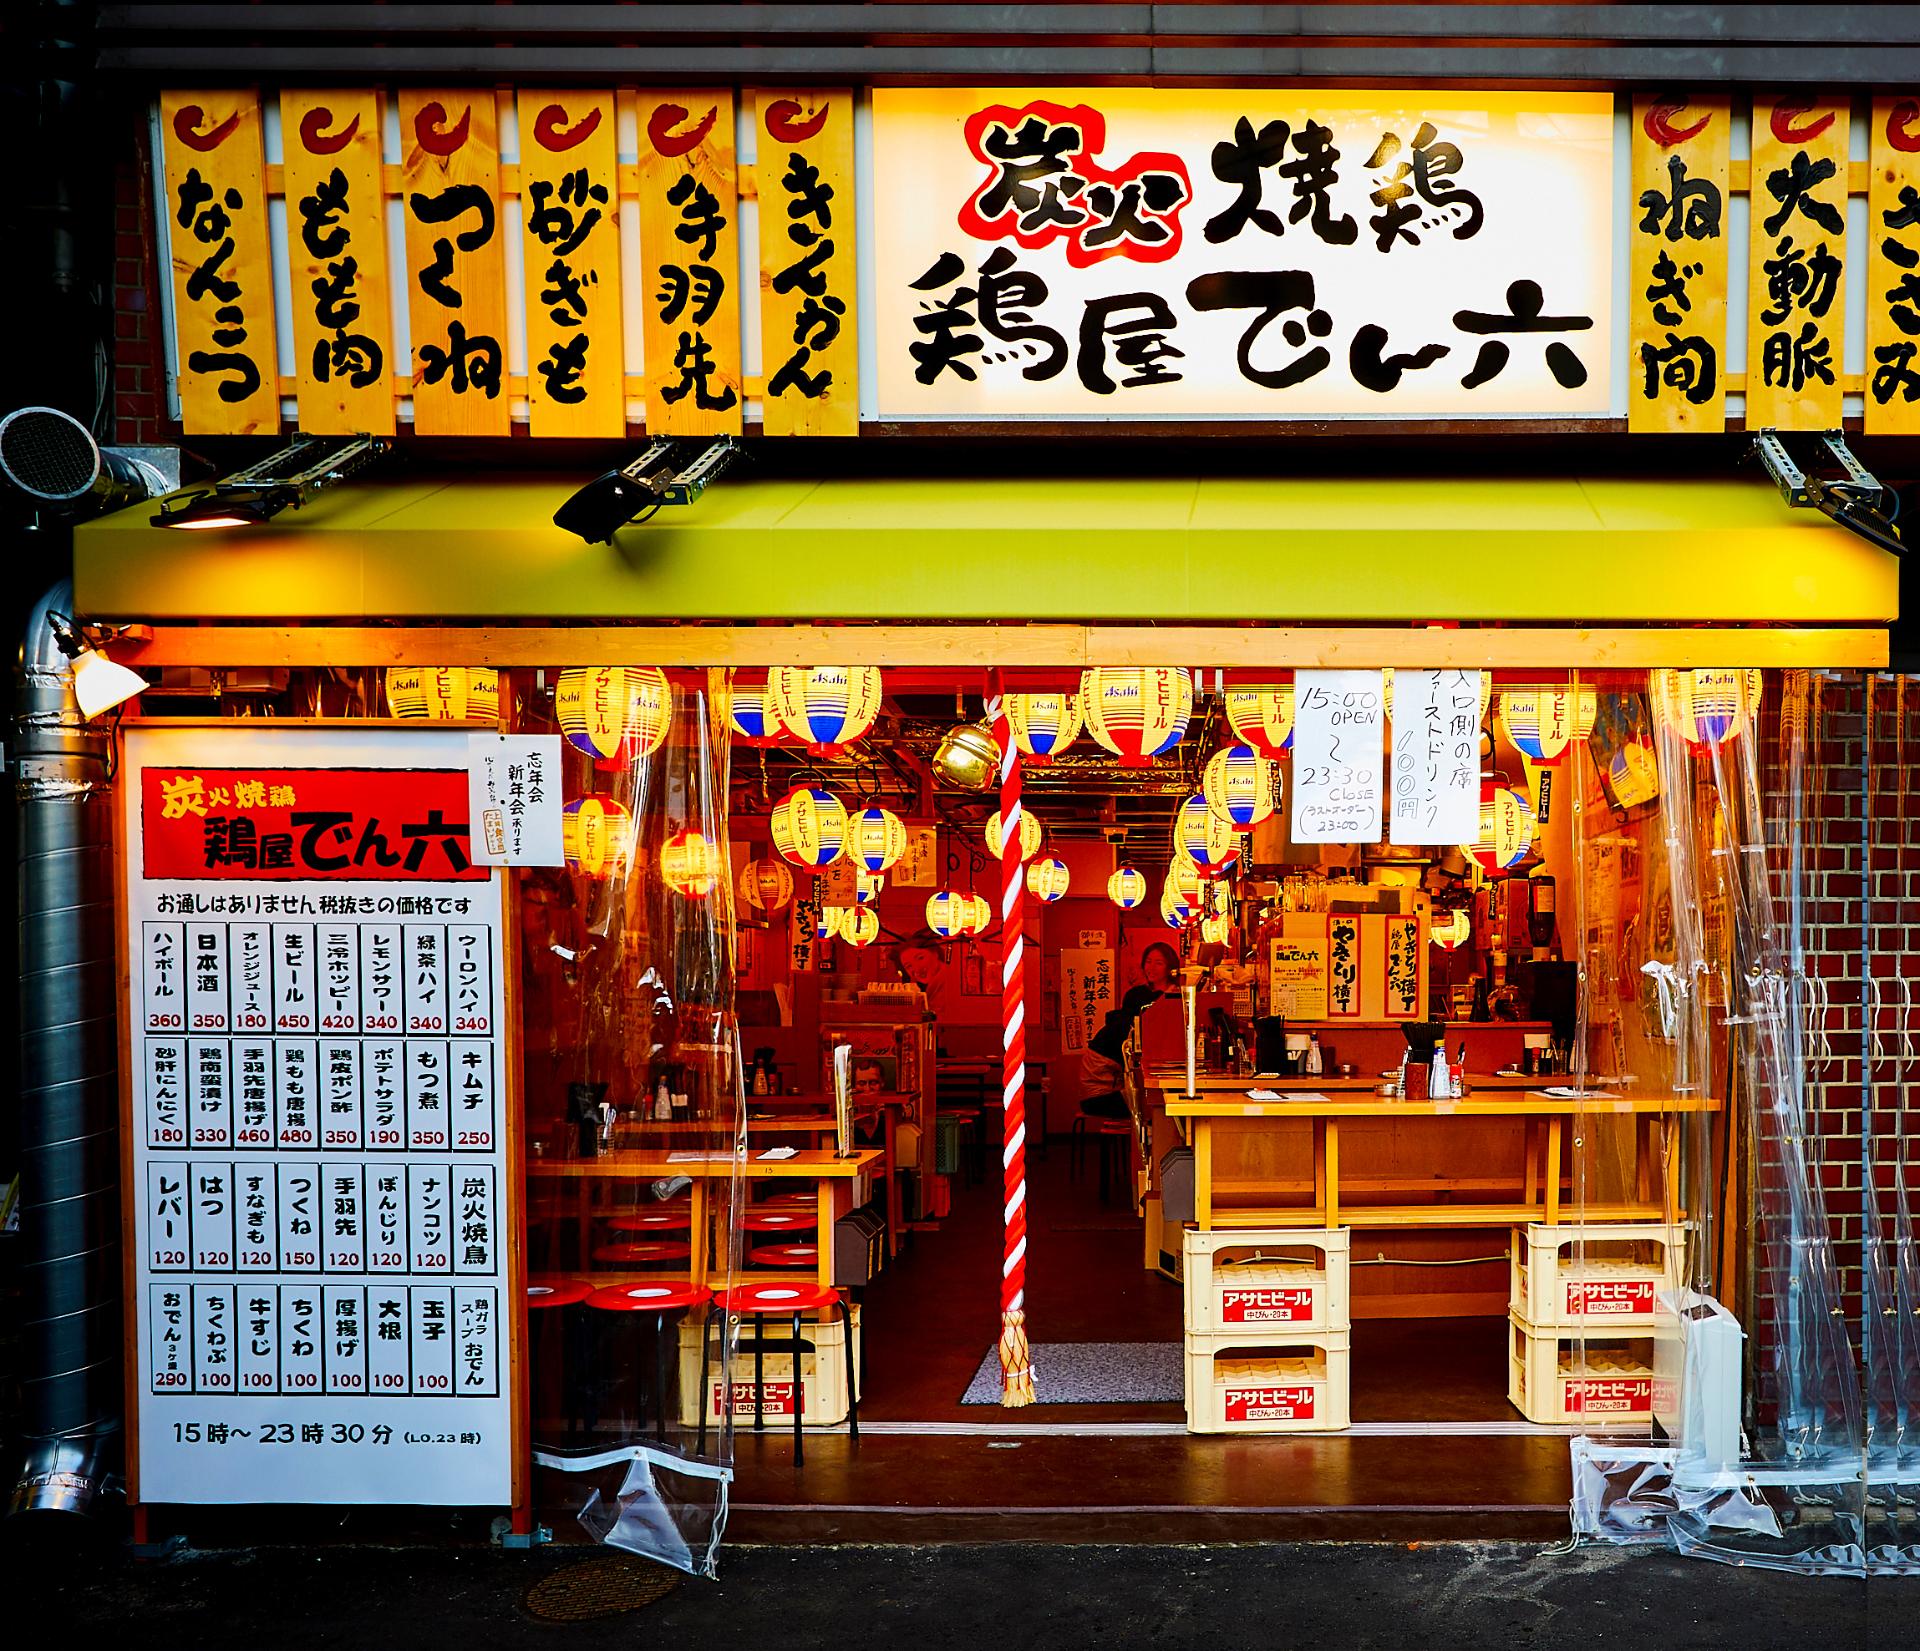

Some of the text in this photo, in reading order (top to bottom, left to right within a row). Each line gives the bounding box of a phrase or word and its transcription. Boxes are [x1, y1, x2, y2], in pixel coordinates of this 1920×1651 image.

[177, 168, 260, 403] なんこつ
[299, 167, 383, 389] もも肉
[528, 168, 609, 404] 砂ぎも
[767, 152, 846, 400] きんかん
[1639, 153, 1722, 402] ねぎ間
[1760, 149, 1844, 391] 大動脈
[411, 184, 501, 400] つくね
[655, 174, 738, 412] 手羽先
[907, 247, 1593, 395] 鶏屋でん六
[393, 678, 419, 690] Asahi
[812, 673, 847, 685] Asahi
[1105, 686, 1138, 697] Asahi
[1153, 669, 1169, 729] サヒビール
[1032, 702, 1058, 710] Asahi
[1331, 709, 1378, 725] OPEN
[1510, 703, 1534, 712] Asahi
[527, 751, 544, 803] 忘年会
[1229, 777, 1254, 785] Asahi
[1301, 766, 1373, 785] 23:30
[161, 775, 296, 819] 炭火焼鶏
[1539, 777, 1550, 818] アサヒビール
[203, 811, 470, 872] 鶏屋でん六
[586, 814, 596, 860] アサヒビール
[797, 801, 811, 848] アサヒビール
[1503, 801, 1514, 851] アサヒビール
[154, 933, 174, 996] ハイボール
[197, 934, 218, 992] 日本酒
[243, 932, 260, 1012] オレンジジュース
[285, 934, 304, 1002] 生ビール
[327, 933, 350, 1011] 三冷ホッピー
[372, 934, 391, 1011] レモンサワー
[417, 935, 437, 1003] 緑茶ハイ
[458, 935, 478, 1012] ウーロンハイ
[1096, 959, 1111, 999] 忘年会
[1332, 926, 1355, 1012] やきとり横丁
[150, 1015, 180, 1028] 360
[194, 1015, 225, 1028] 350
[236, 1015, 266, 1028] 180
[278, 1015, 309, 1028] 450
[322, 1016, 354, 1029] 420
[366, 1016, 397, 1029] 340
[410, 1017, 442, 1030] 340
[456, 1017, 487, 1030] 340
[1083, 976, 1097, 1039] 新年会承りま
[155, 1047, 177, 1125] 砂肝にんにく
[243, 1048, 268, 1126] 手羽先唐揚げ
[285, 1049, 305, 1127] 鶏もも唐揚
[330, 1050, 353, 1113] 鶏皮ポン酢
[374, 1048, 395, 1126] ポテトサラダ
[417, 1051, 439, 1110] もつ煮
[462, 1052, 483, 1110] キムチ
[154, 1129, 183, 1142] 180
[195, 1129, 226, 1142] 330
[238, 1129, 270, 1142] 460
[280, 1130, 312, 1143] 480
[325, 1131, 357, 1144] 350
[370, 1131, 400, 1143] 190
[413, 1132, 444, 1144] 350
[458, 1132, 490, 1145] 250
[158, 1176, 182, 1238] レバー
[200, 1176, 223, 1215] はつ
[246, 1176, 266, 1244] すなぎも
[290, 1178, 312, 1235] つくね
[334, 1177, 357, 1236] 手羽先
[378, 1176, 398, 1245] ぼんじり
[422, 1178, 441, 1245] ナンコツ
[461, 1178, 488, 1265] 炭火焼鳥
[155, 1251, 185, 1264] 120
[200, 1252, 228, 1265] 120
[242, 1252, 271, 1265] 120
[285, 1252, 315, 1265] 150
[329, 1253, 359, 1266] 120
[372, 1253, 402, 1266] 120
[416, 1254, 446, 1267] 120
[1224, 1291, 1311, 1307] アサヒビール
[1568, 1284, 1653, 1300] アサヒビール
[206, 1296, 226, 1363] ちくわぶ
[249, 1298, 271, 1356] 牛すじ
[291, 1299, 314, 1356] ちくわ
[335, 1299, 359, 1357] 厚揚げ
[378, 1300, 402, 1340] 大根
[422, 1300, 446, 1340] 玉子
[155, 1373, 187, 1386] 290
[201, 1374, 231, 1386] 100
[243, 1374, 273, 1387] 100
[286, 1374, 317, 1387] 100
[332, 1374, 362, 1387] 100
[374, 1374, 404, 1387] 100
[418, 1375, 448, 1388] 100
[1227, 1390, 1313, 1406] アサヒビール
[1567, 1382, 1650, 1397] アサヒビール
